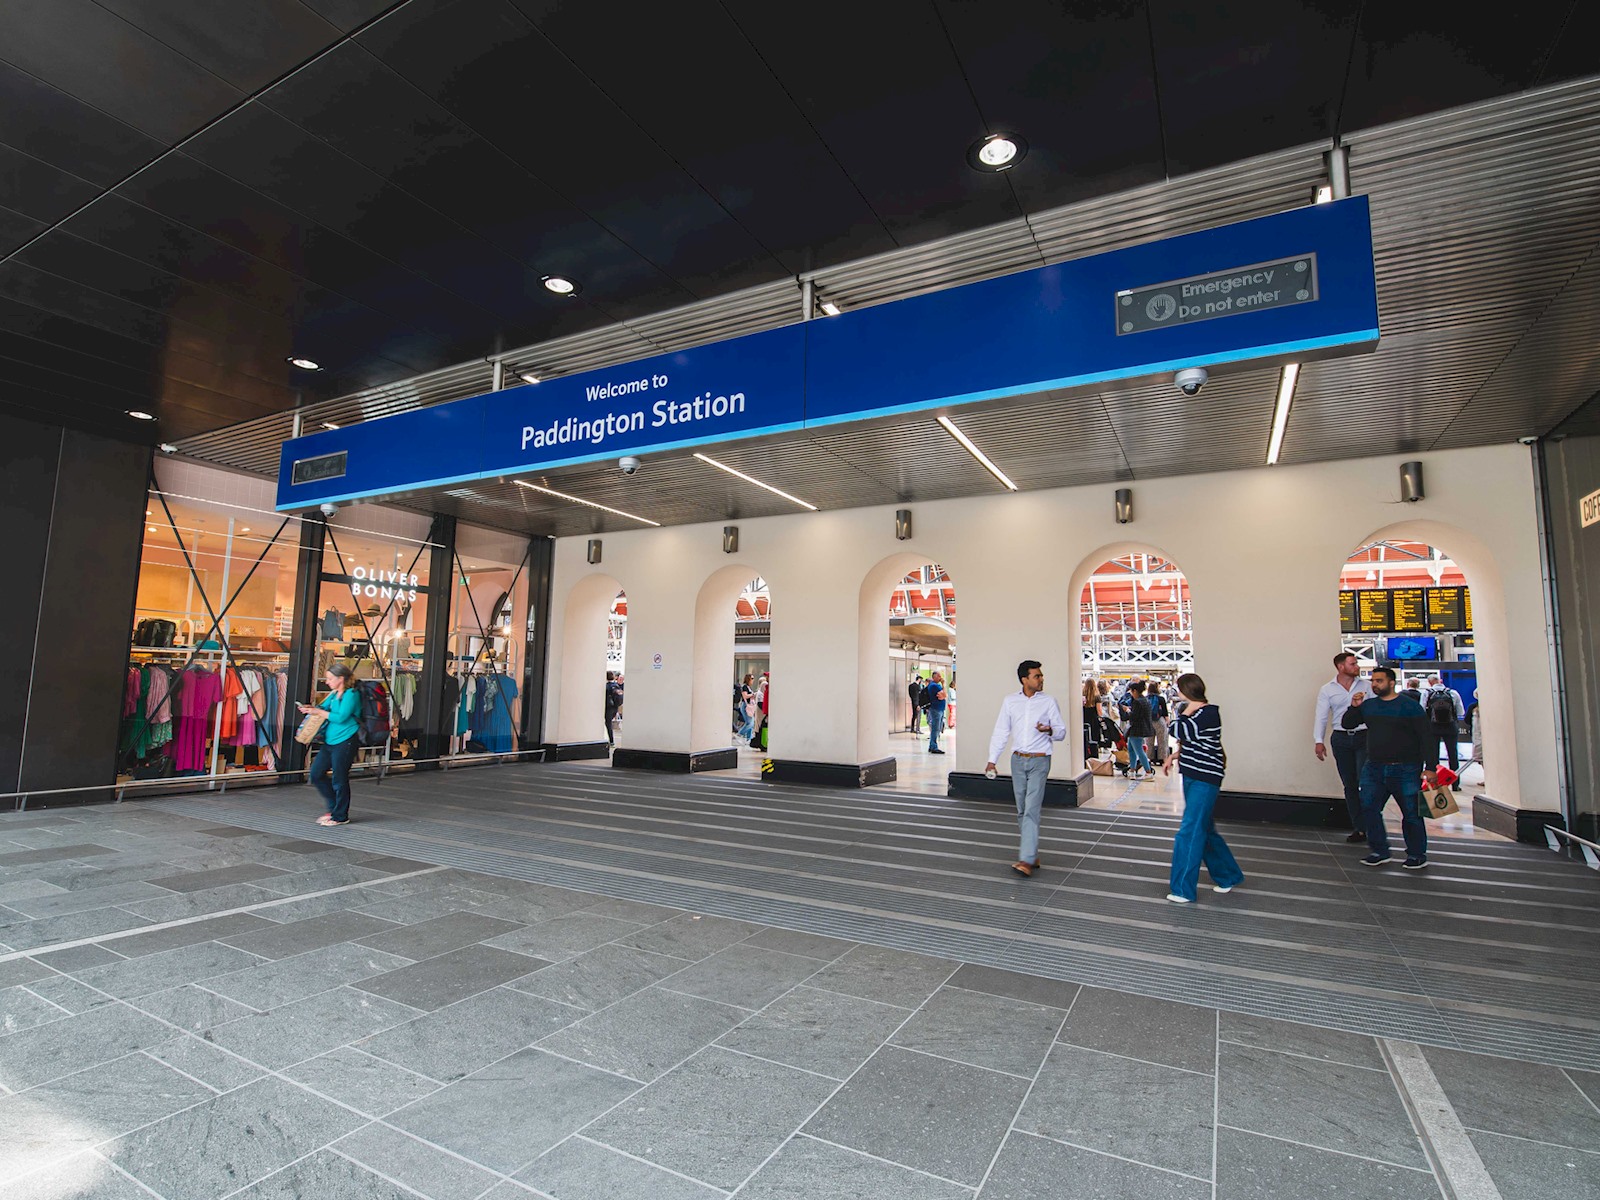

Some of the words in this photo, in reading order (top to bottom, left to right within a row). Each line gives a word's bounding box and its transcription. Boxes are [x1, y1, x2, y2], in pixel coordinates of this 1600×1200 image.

[1182, 270, 1275, 298] Emergency
[1178, 305, 1201, 319] Do
[1206, 297, 1232, 313] not
[1236, 290, 1281, 308] enter
[585, 378, 649, 402] Welcome
[652, 374, 668, 389] to
[521, 411, 645, 451] Paddington
[651, 391, 745, 428] Station
[353, 566, 418, 587] OLIVER
[352, 582, 417, 602] BONAS
